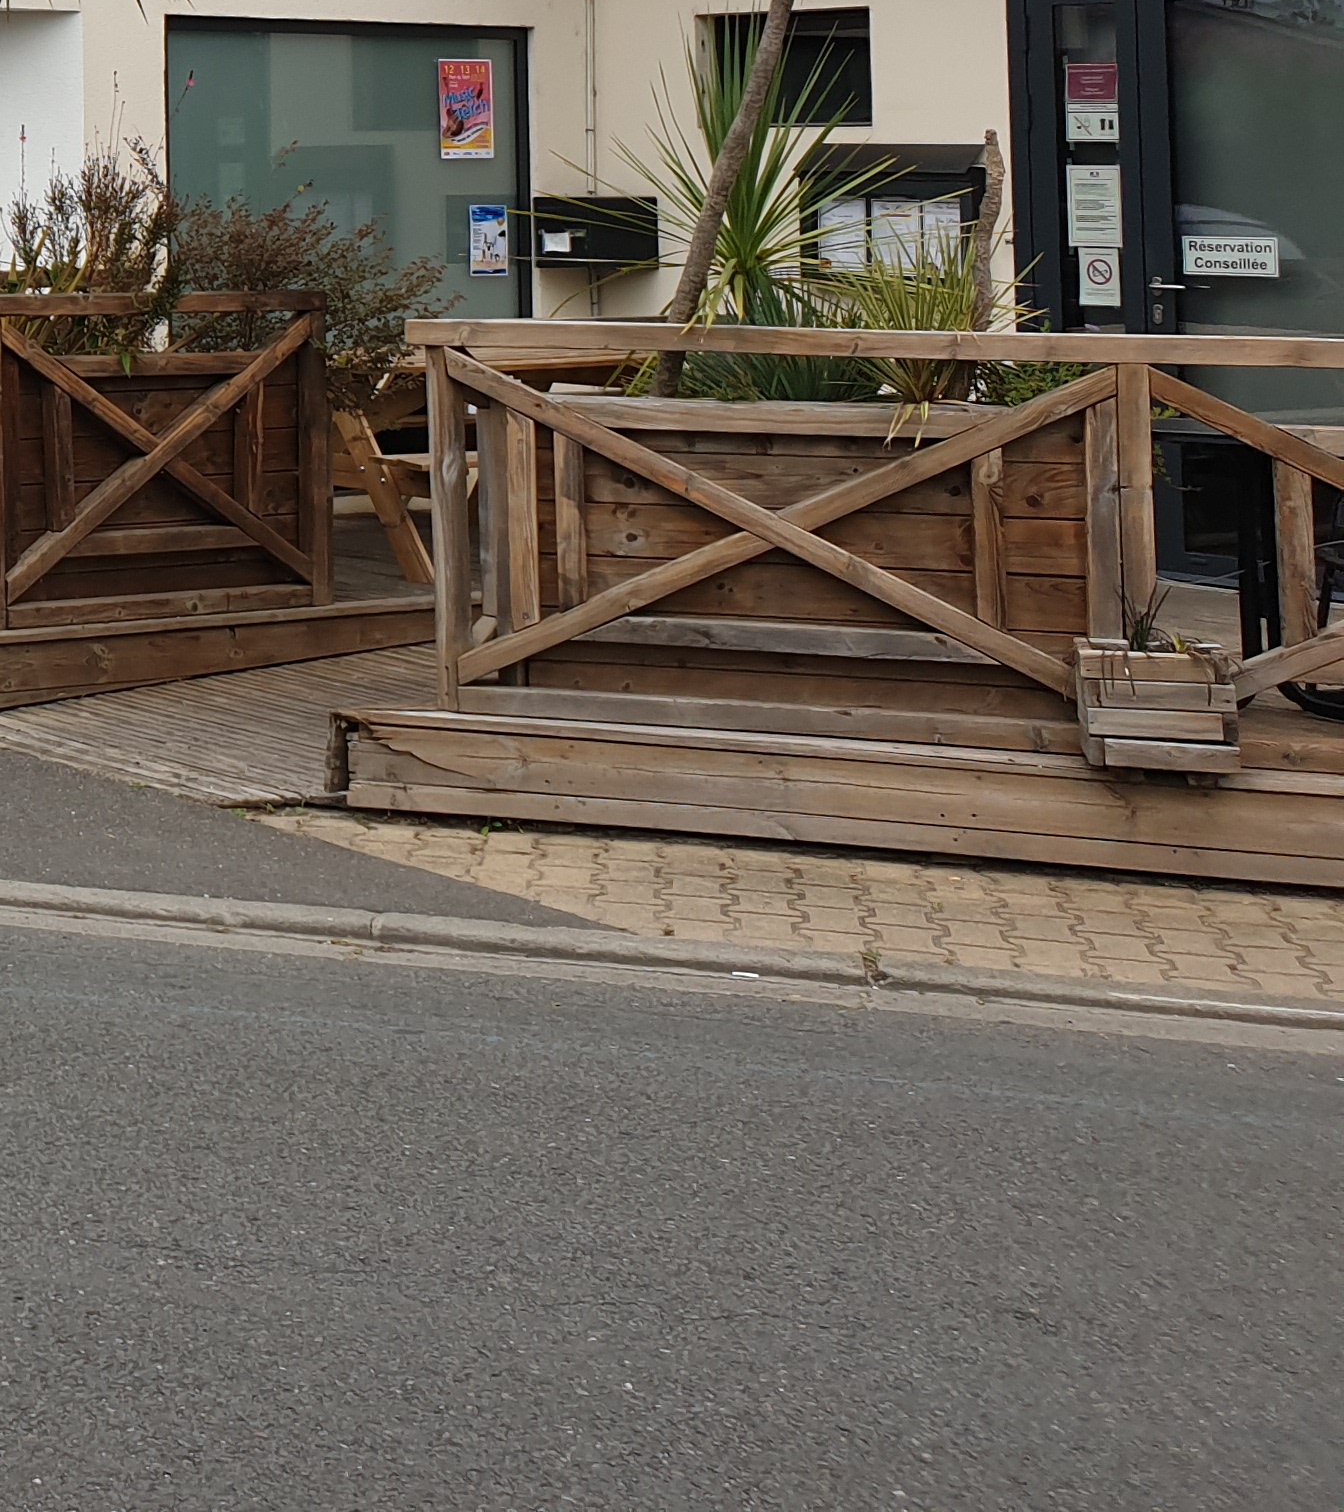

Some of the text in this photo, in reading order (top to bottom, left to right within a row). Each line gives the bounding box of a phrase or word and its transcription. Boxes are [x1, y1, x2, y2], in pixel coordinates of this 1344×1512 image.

[444, 65, 454, 74] 12
[460, 65, 470, 74] 13
[1188, 240, 1272, 254] Réservation
[1194, 257, 1267, 270] Conseillée
